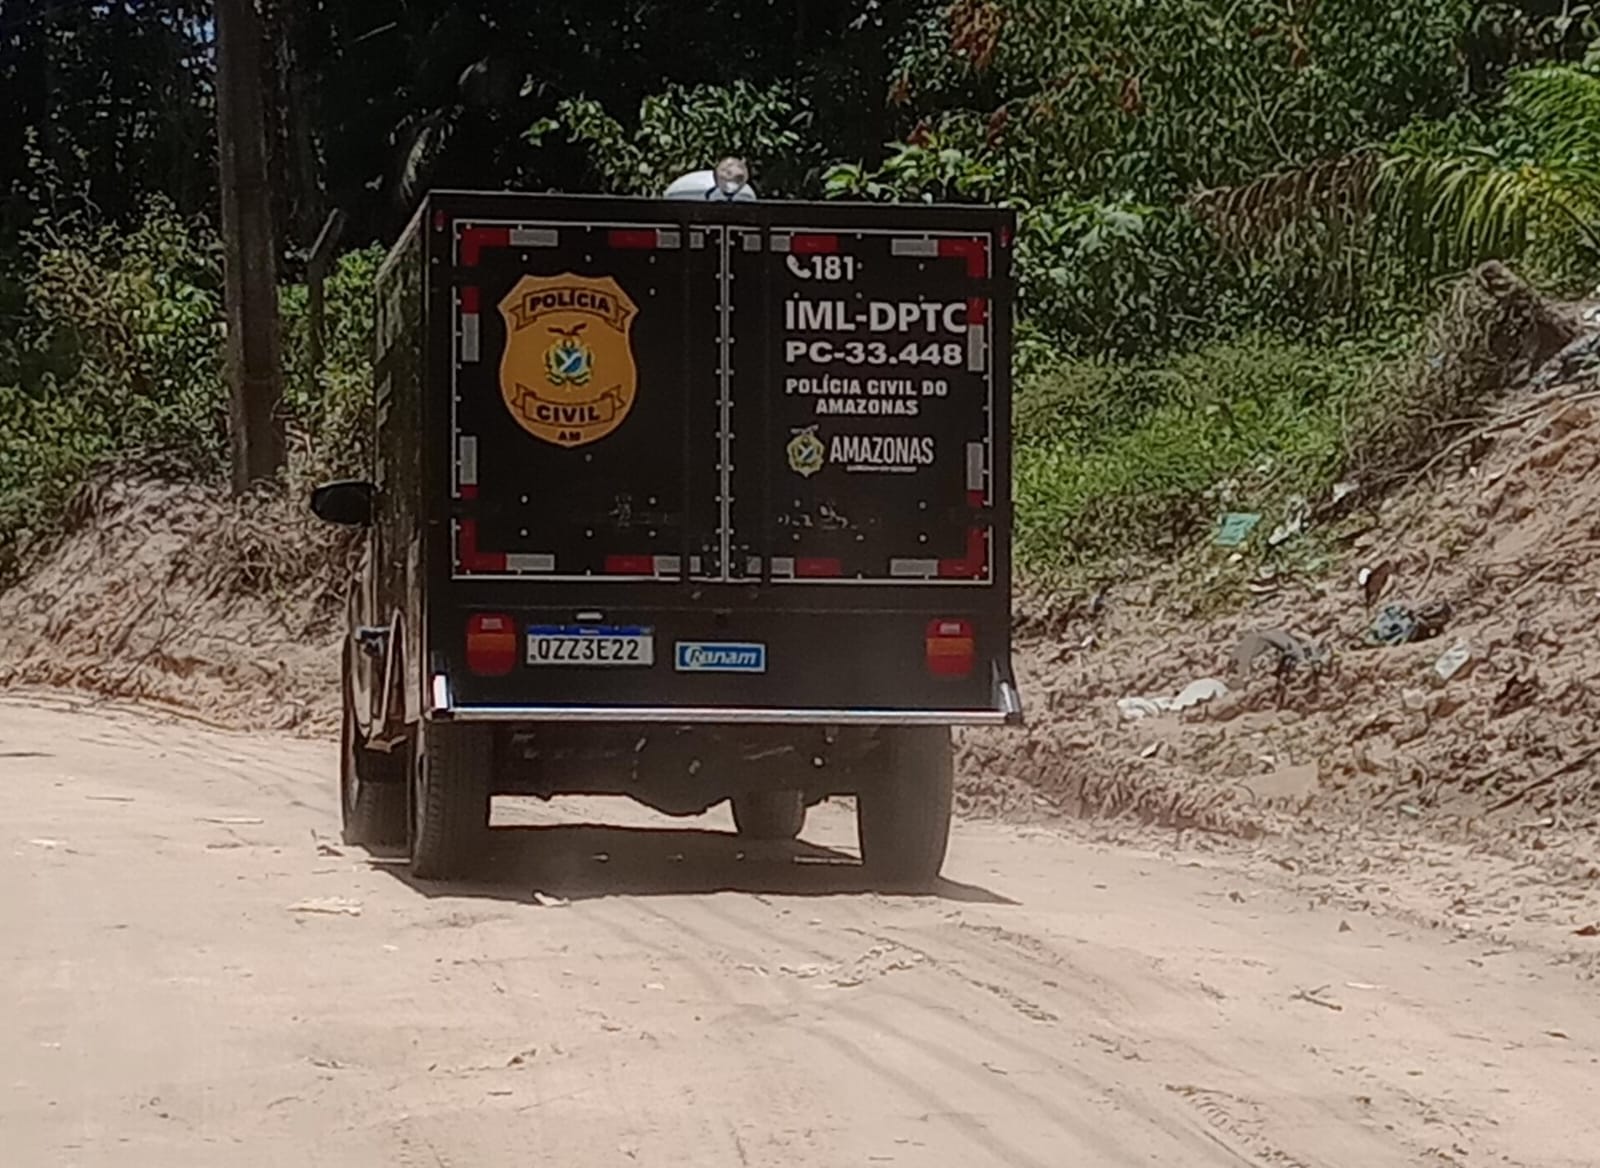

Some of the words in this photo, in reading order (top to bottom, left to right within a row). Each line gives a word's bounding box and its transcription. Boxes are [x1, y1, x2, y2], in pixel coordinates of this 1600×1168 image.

[811, 255, 854, 281] 181
[529, 288, 610, 312] POLÍCIA
[785, 299, 968, 334] IML-DPTC
[785, 340, 963, 366] PC-33.448
[785, 373, 862, 395] POLÍCIA
[866, 379, 918, 396] CIVIL
[921, 380, 948, 396] DO
[536, 405, 600, 423] CIVIL
[815, 398, 919, 416] AMAZONAS
[558, 431, 581, 441] AM
[829, 435, 934, 465] AMAZONAS
